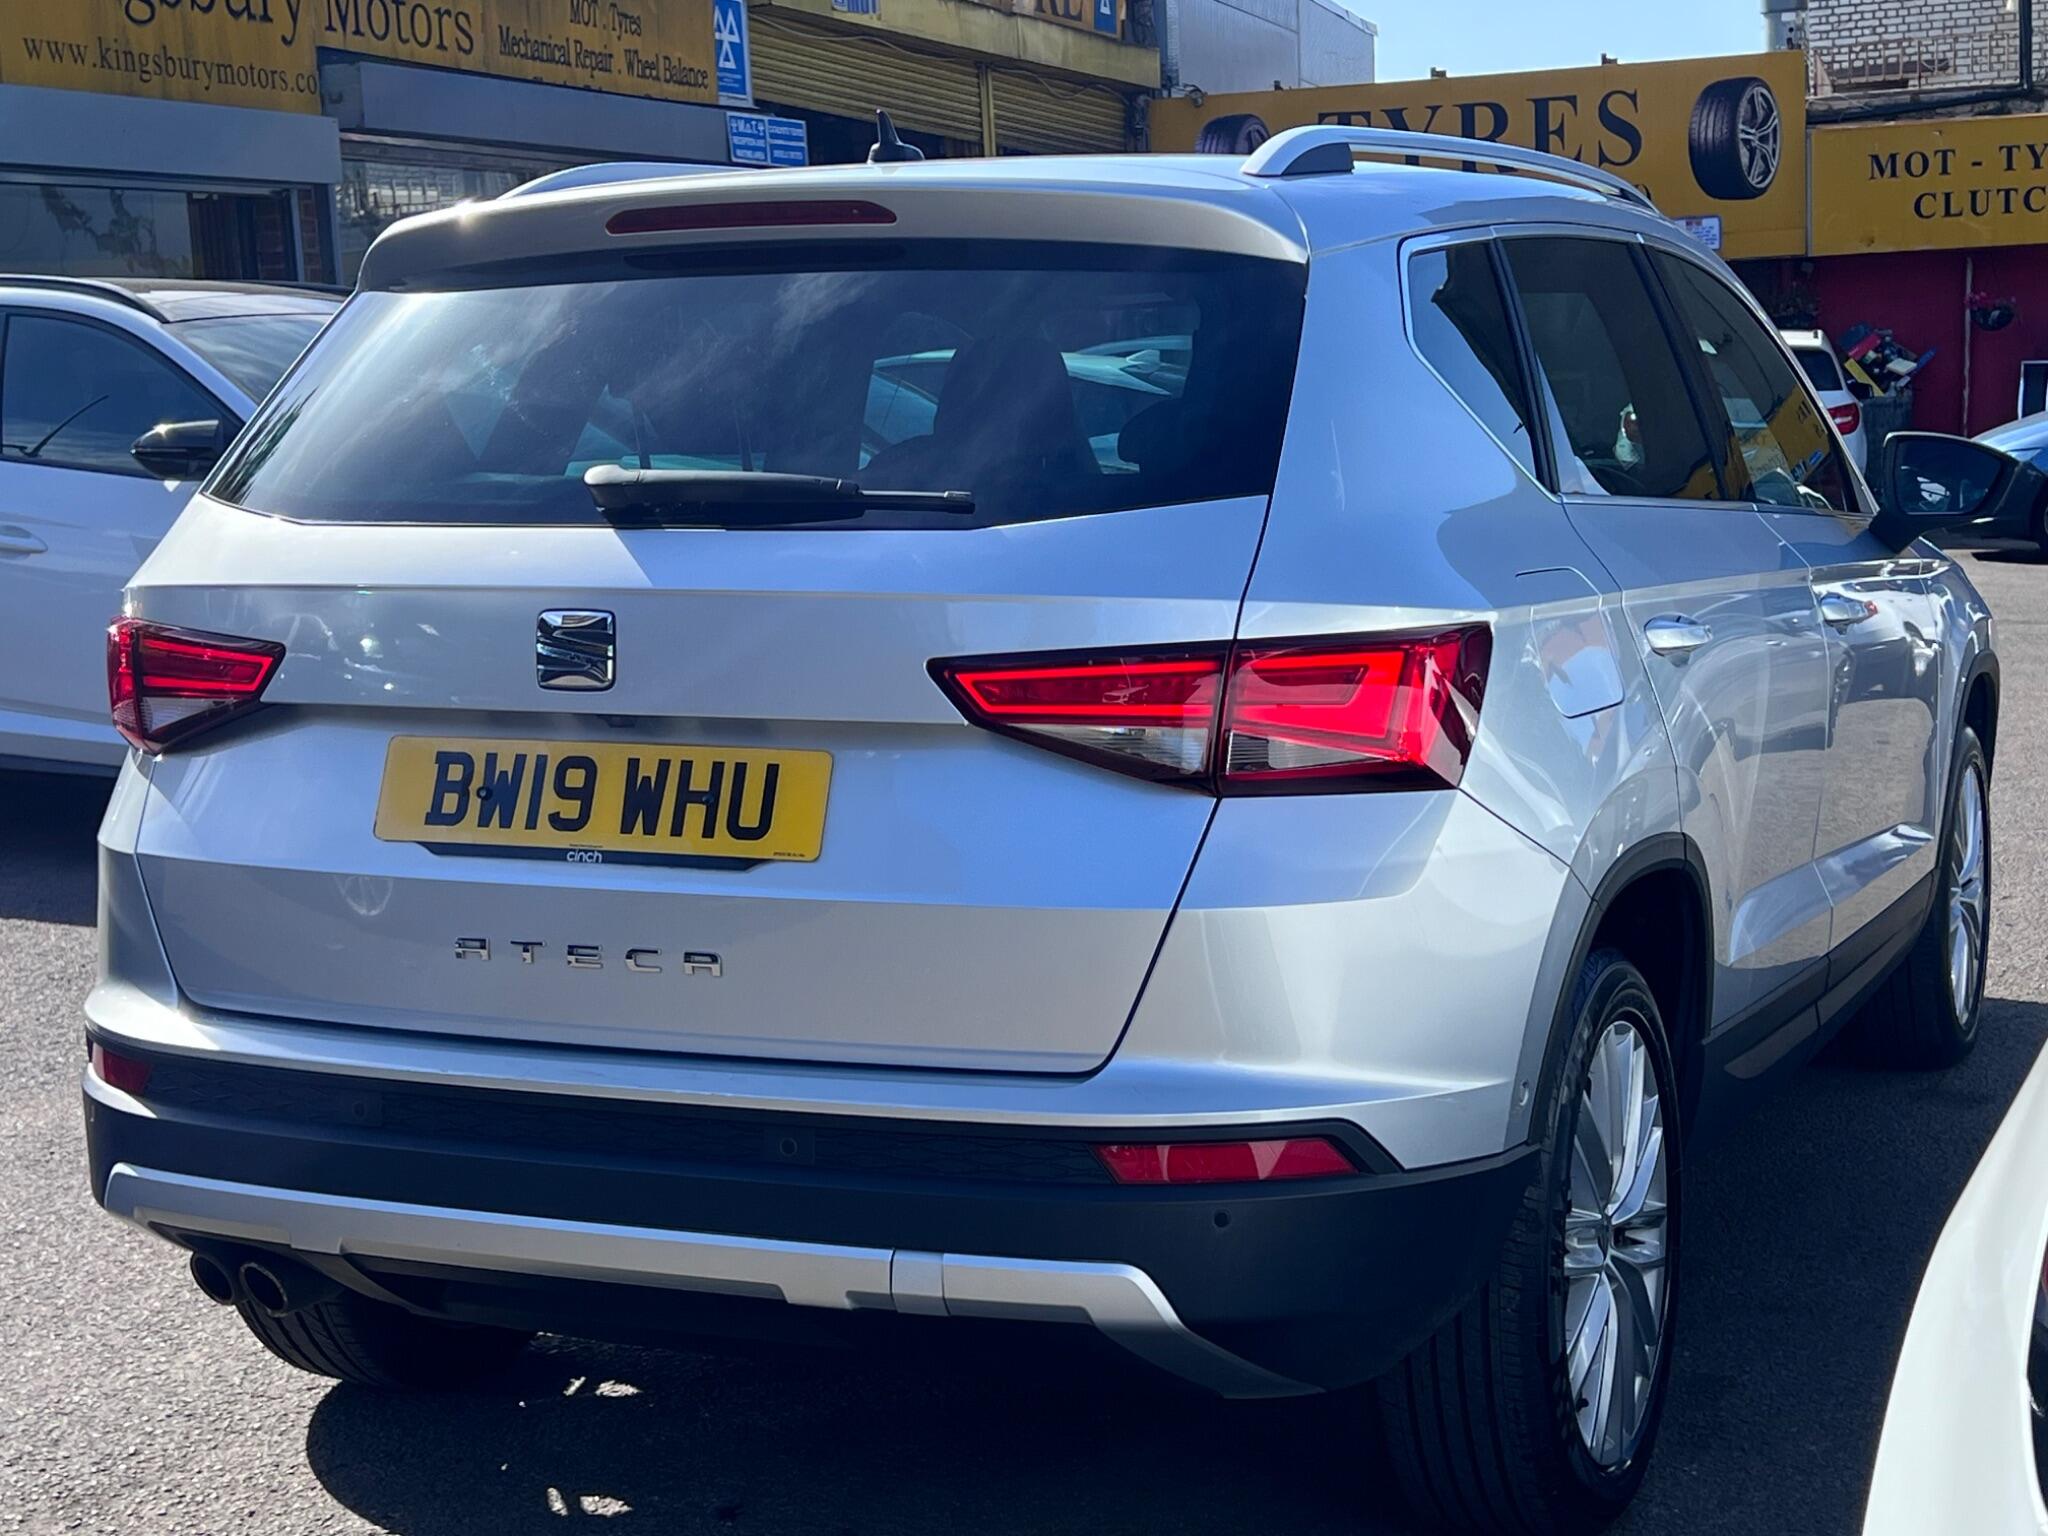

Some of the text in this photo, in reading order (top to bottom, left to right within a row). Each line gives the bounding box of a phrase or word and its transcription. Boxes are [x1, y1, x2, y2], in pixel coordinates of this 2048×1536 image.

[325, 0, 475, 55] Motors
[569, 0, 599, 27] MOT
[608, 4, 642, 41] Tyres
[23, 36, 317, 95] www.kingsburymotors.co
[498, 24, 571, 68] Mechanical
[573, 39, 614, 78] Repair
[623, 48, 659, 82] Wheel
[663, 55, 709, 90] Balance
[1868, 149, 1956, 180] MOT
[1913, 186, 2048, 219] CLUTC
[424, 751, 780, 841] BW19 WHU
[566, 848, 603, 863] cinch
[455, 936, 723, 978] ATECA
